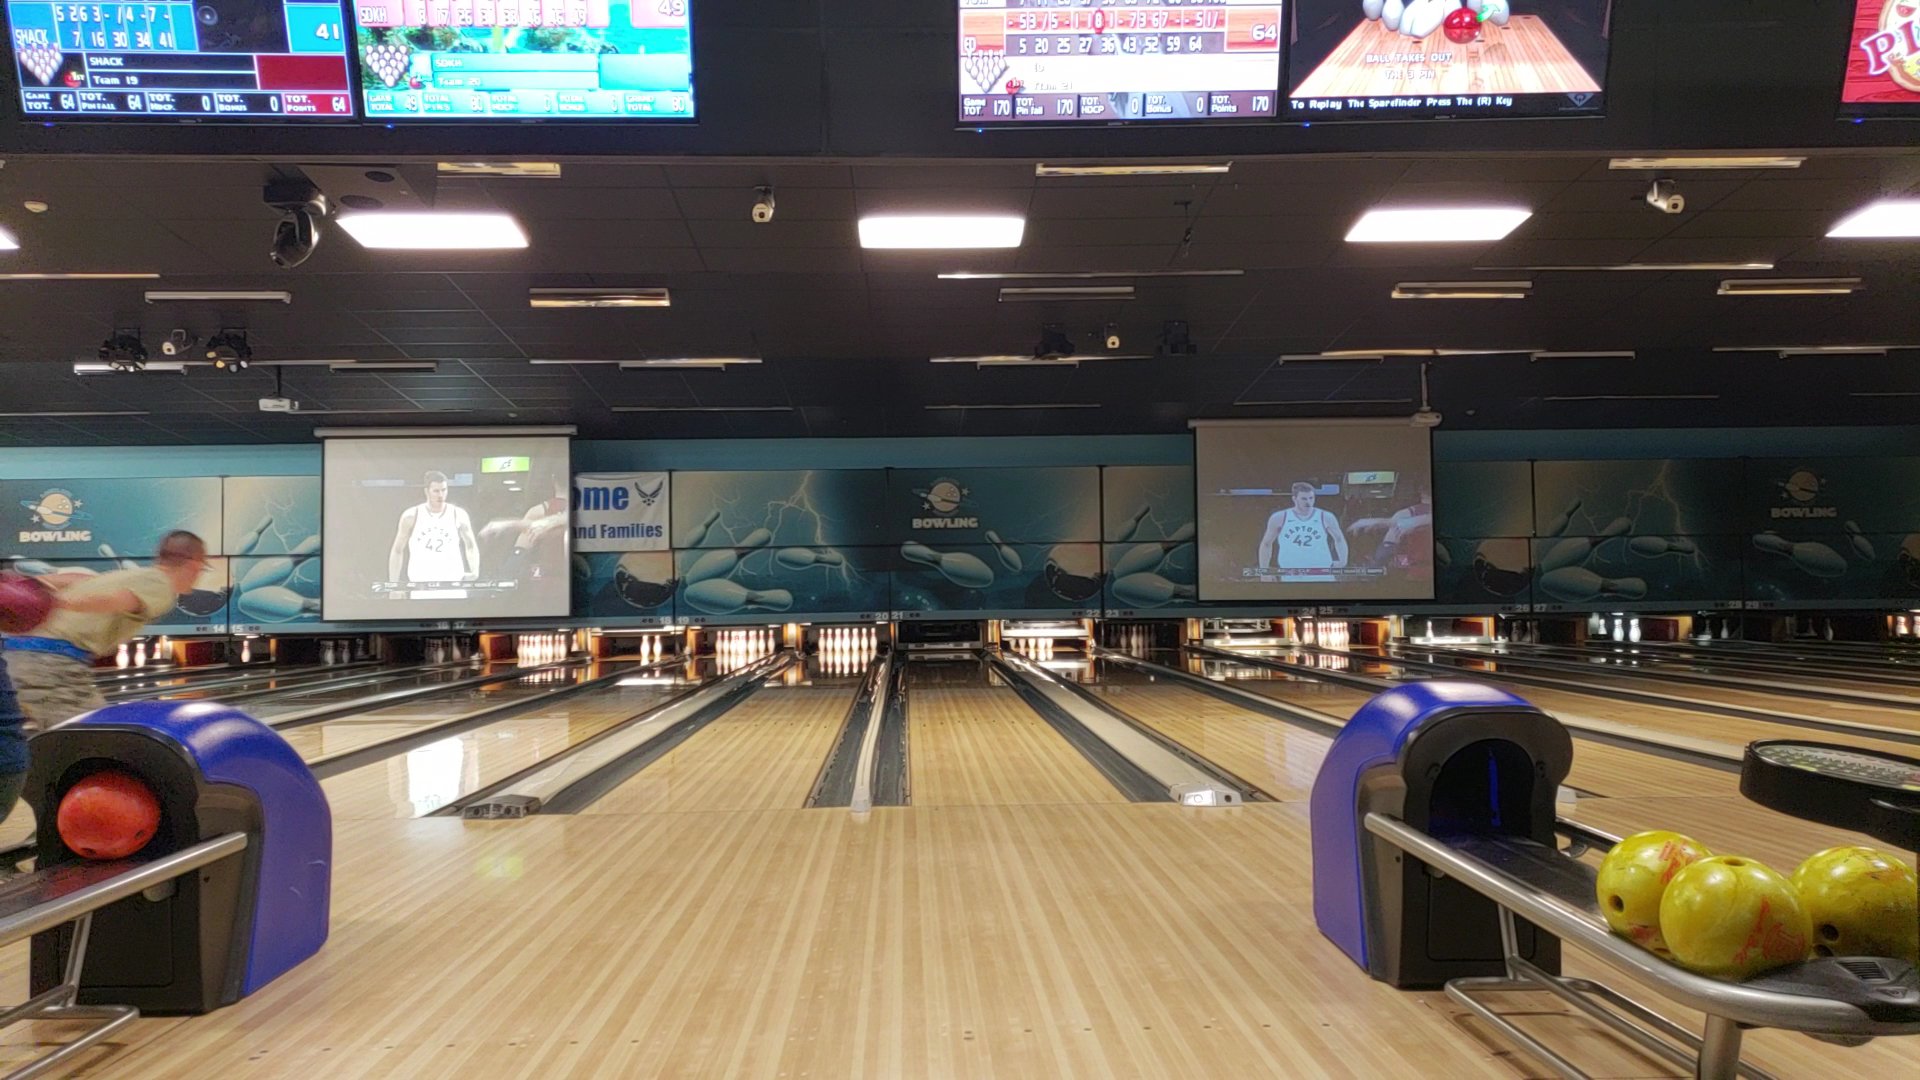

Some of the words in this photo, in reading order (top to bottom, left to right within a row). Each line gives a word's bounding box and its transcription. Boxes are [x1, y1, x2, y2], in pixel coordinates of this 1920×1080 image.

[315, 24, 340, 39] 41
[1252, 24, 1277, 41] 64
[15, 29, 49, 45] SHACK
[73, 31, 80, 47] 7
[91, 32, 104, 47] 16
[113, 32, 127, 47] 30
[135, 32, 149, 47] 34
[159, 32, 173, 47] 41
[1020, 38, 1027, 53] 5
[1035, 38, 1048, 53] 20
[1057, 38, 1070, 53] 25
[1079, 37, 1092, 53] 27
[1101, 37, 1115, 53] 36
[1123, 37, 1136, 52] 43
[1145, 37, 1158, 53] 52
[1167, 36, 1180, 51] 59
[1189, 36, 1202, 52] 64
[90, 57, 123, 66] SHACK
[1366, 54, 1389, 63] BALL
[1395, 53, 1425, 62] TAKES
[1431, 53, 1452, 62] OUT
[1407, 70, 1414, 79] 3
[1419, 70, 1435, 79] PIN
[126, 76, 138, 85] 19
[60, 94, 75, 109] 64
[81, 92, 106, 101] TOT.
[149, 93, 175, 102] TOT.
[218, 94, 243, 103] TOT.
[286, 95, 311, 103] TOT.
[1081, 97, 1099, 105] TOT.
[1211, 95, 1230, 104] TOT.
[26, 102, 52, 110] TOT.
[127, 94, 142, 110] 64
[202, 95, 211, 111] 0
[270, 96, 278, 112] 0
[332, 97, 346, 112] 64
[1057, 99, 1073, 115] 170
[1131, 98, 1138, 114] 0
[1196, 97, 1203, 112] 0
[1252, 96, 1269, 111] 170
[1292, 100, 1305, 109] To
[1309, 100, 1342, 110] Replay
[1348, 99, 1364, 108] The
[1426, 97, 1451, 106] Press
[1477, 96, 1491, 106] (R)
[993, 99, 1010, 116] 170
[1770, 507, 1837, 518] BOWLING
[912, 517, 978, 529] BOWLING
[601, 523, 663, 538] Families
[19, 530, 91, 542] BOWLING
[1293, 534, 1312, 546] 42
[425, 538, 443, 552] 42
[1086, 609, 1099, 617] 22
[1105, 609, 1119, 617] 23
[1319, 606, 1333, 614] 25
[1534, 604, 1547, 612] 27
[677, 616, 689, 625] 19
[875, 612, 889, 620] 20
[892, 611, 903, 620] 21
[213, 624, 225, 633] 14
[231, 624, 243, 633] 15
[455, 620, 466, 629] 17
